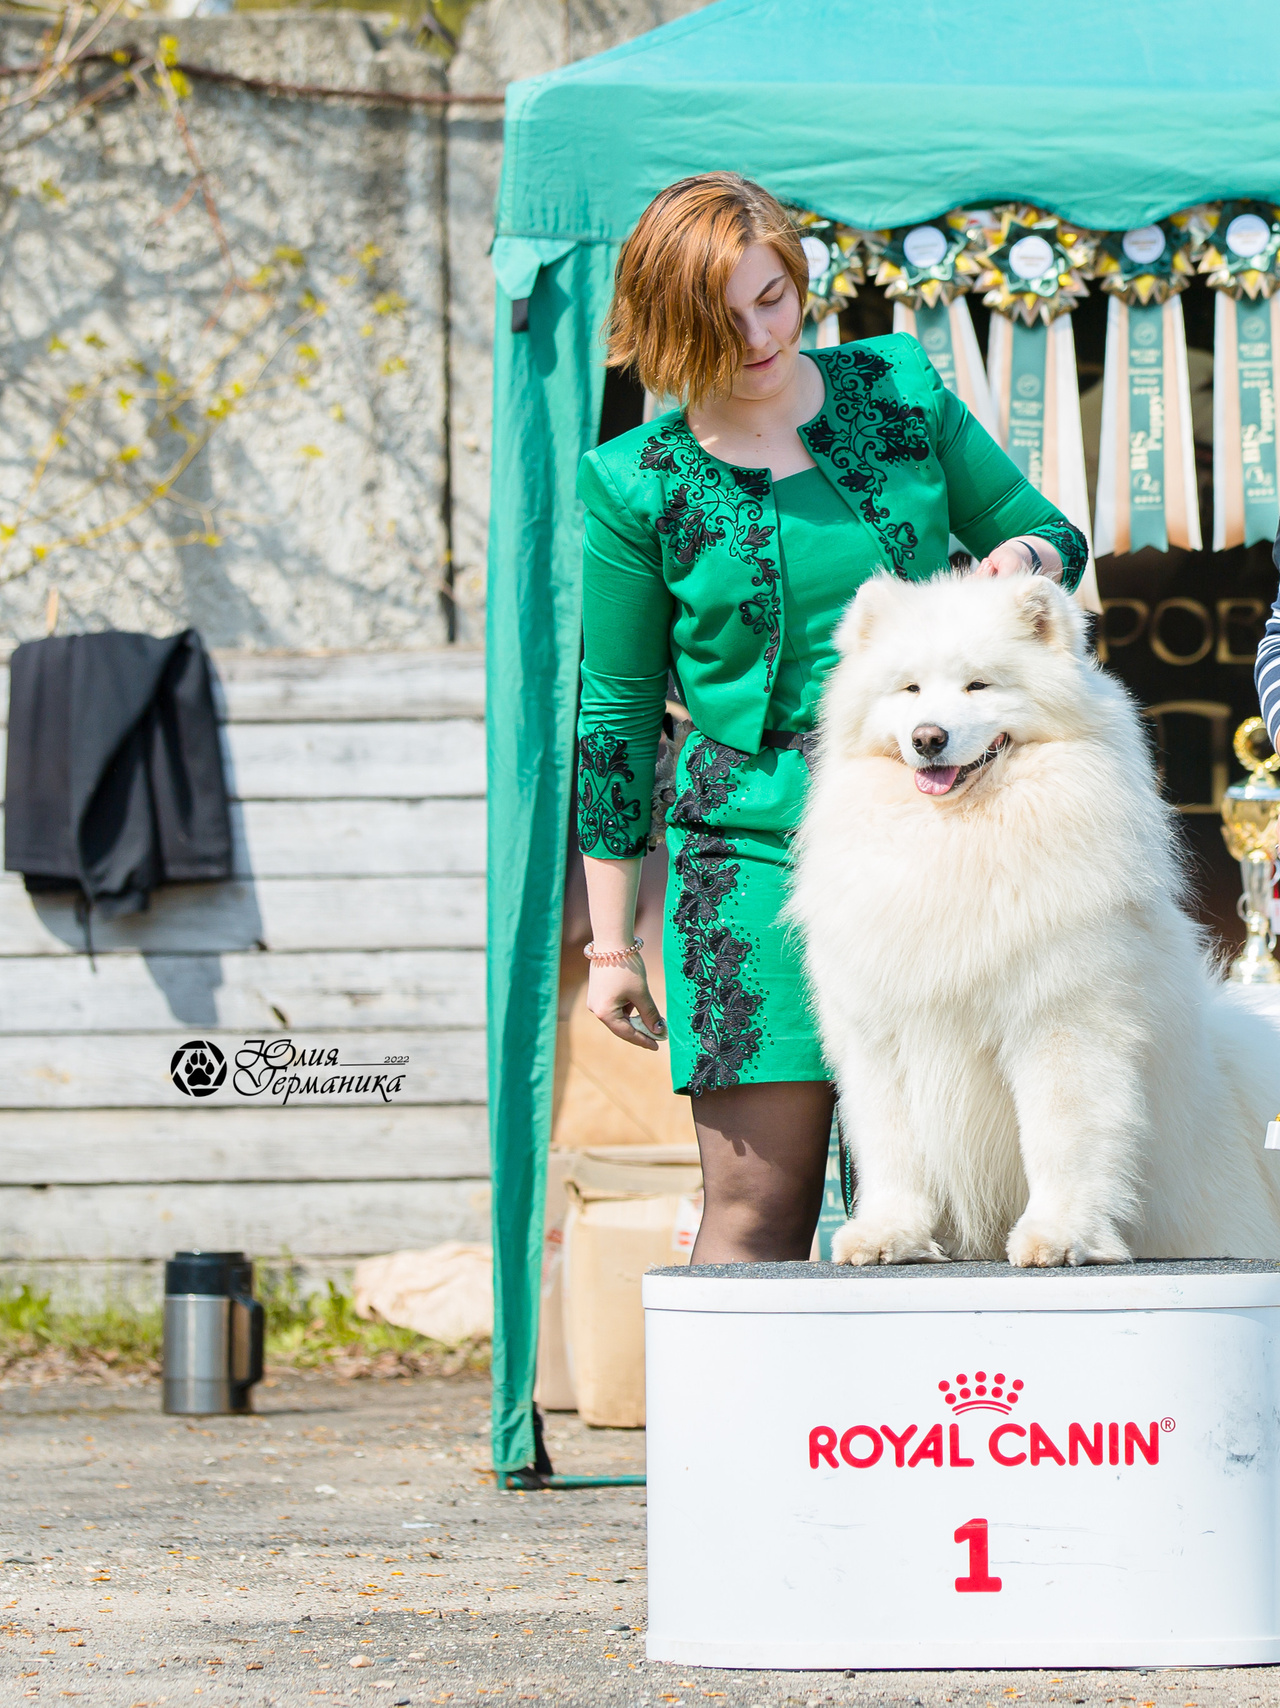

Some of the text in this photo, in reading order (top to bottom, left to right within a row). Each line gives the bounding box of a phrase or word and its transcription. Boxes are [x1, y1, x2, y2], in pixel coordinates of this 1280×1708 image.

[1146, 394, 1164, 450] Puppy
[1258, 388, 1275, 443] Puppy
[1130, 430, 1148, 470] BIS
[1242, 424, 1260, 463] BIS
[809, 1423, 975, 1469] ROYAL
[954, 1518, 1002, 1593] 1
